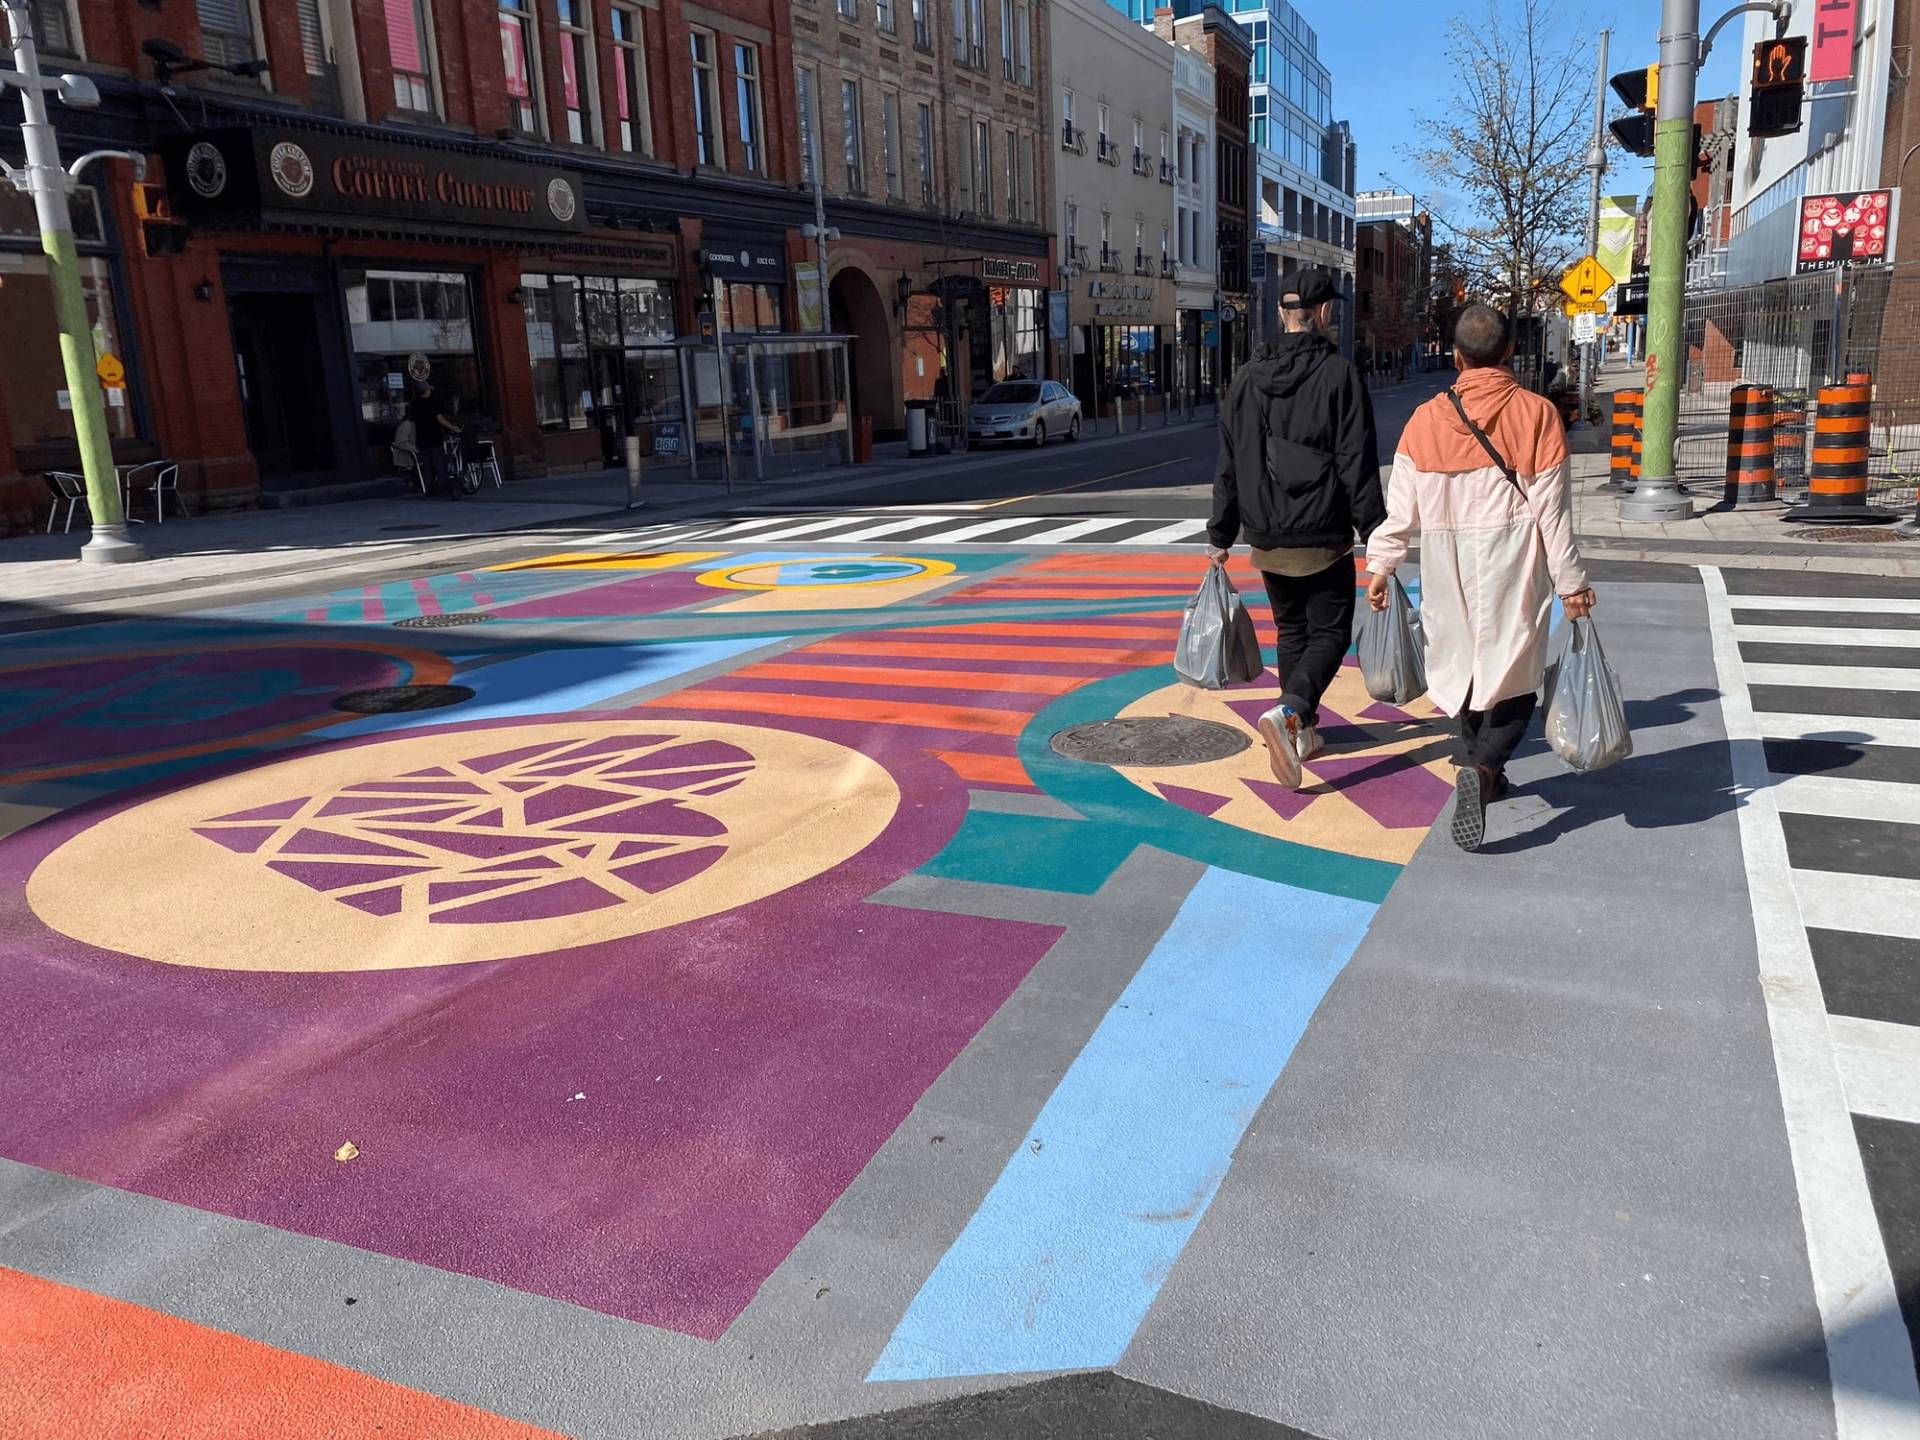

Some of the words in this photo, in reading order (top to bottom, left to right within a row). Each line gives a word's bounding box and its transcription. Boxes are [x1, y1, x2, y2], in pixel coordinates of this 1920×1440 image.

[331, 157, 429, 201] COFFEE
[436, 170, 536, 213] CULTURE
[1799, 257, 1882, 271] THEMUSM
